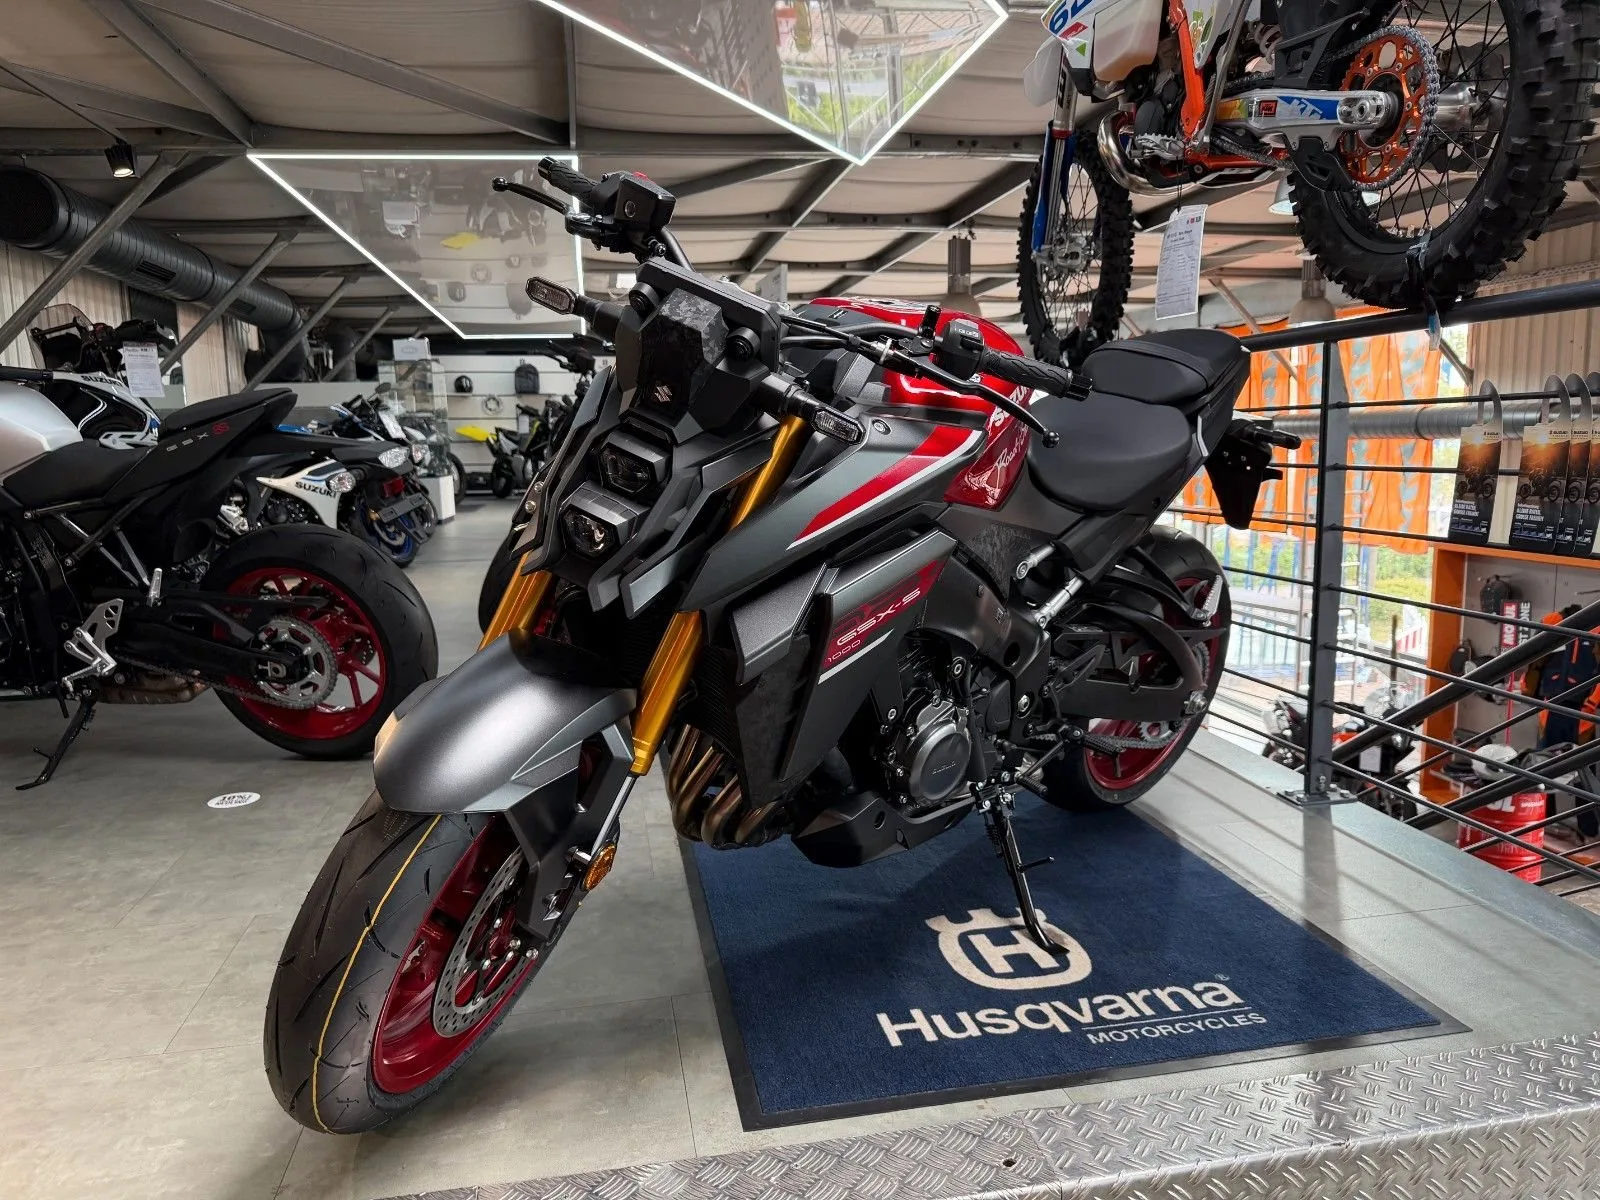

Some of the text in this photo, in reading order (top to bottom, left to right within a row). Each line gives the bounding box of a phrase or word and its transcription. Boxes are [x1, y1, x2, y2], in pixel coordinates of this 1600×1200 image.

[80, 375, 123, 387] SUZUKI
[295, 481, 337, 498] SUZUKI
[837, 586, 921, 646] GSX-S
[827, 639, 861, 663] 1000
[876, 980, 1244, 1047] Husqvarna
[1086, 1012, 1267, 1045] MOTORCYCLES
